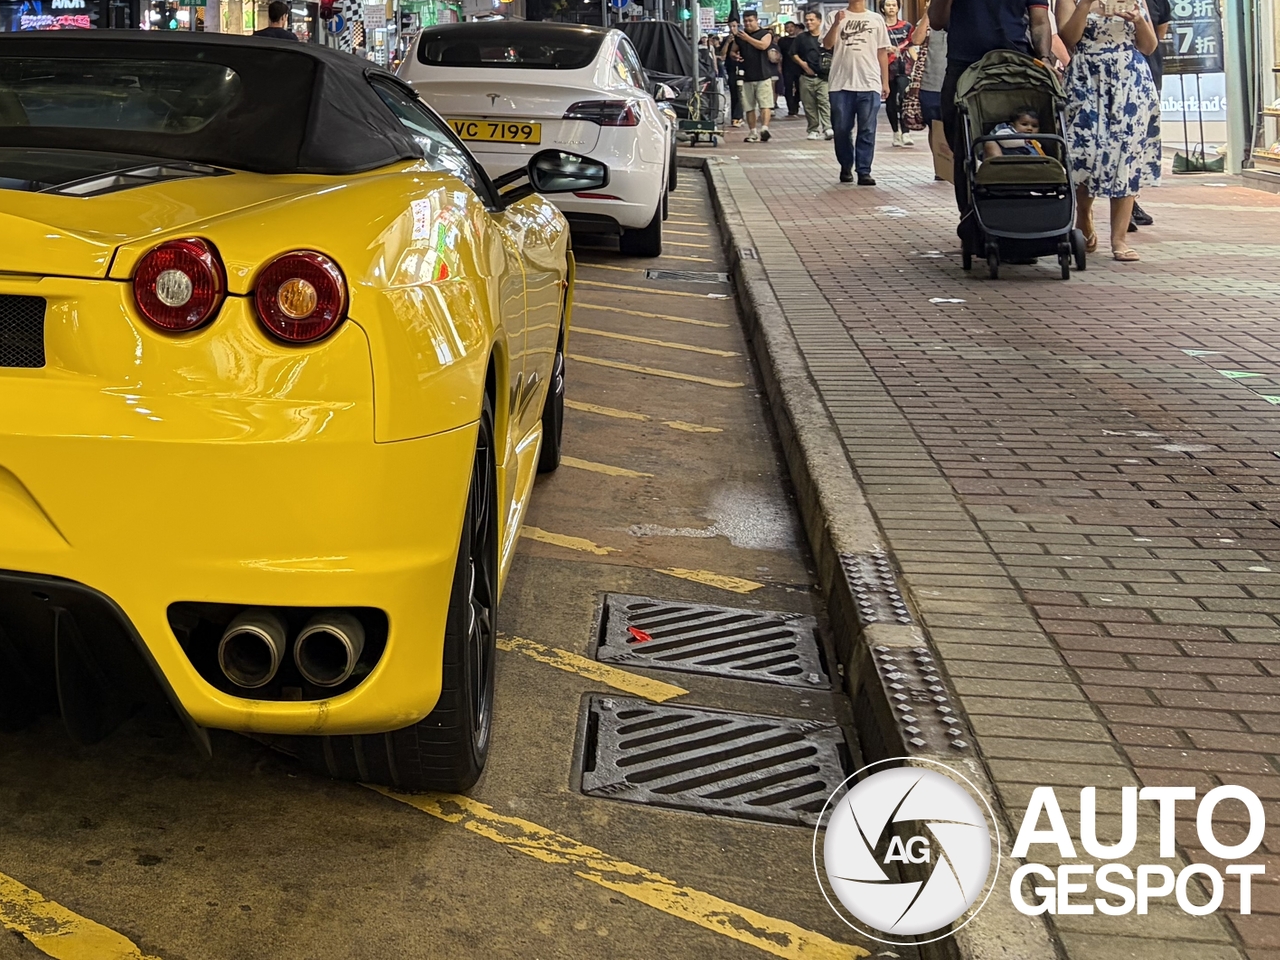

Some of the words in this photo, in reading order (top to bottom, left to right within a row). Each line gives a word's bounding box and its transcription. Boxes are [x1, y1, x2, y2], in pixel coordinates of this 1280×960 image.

[845, 20, 870, 31] NIKE
[1176, 26, 1216, 54] 7折
[1160, 95, 1220, 113] mberland
[454, 122, 479, 138] VC
[488, 123, 533, 140] 7199
